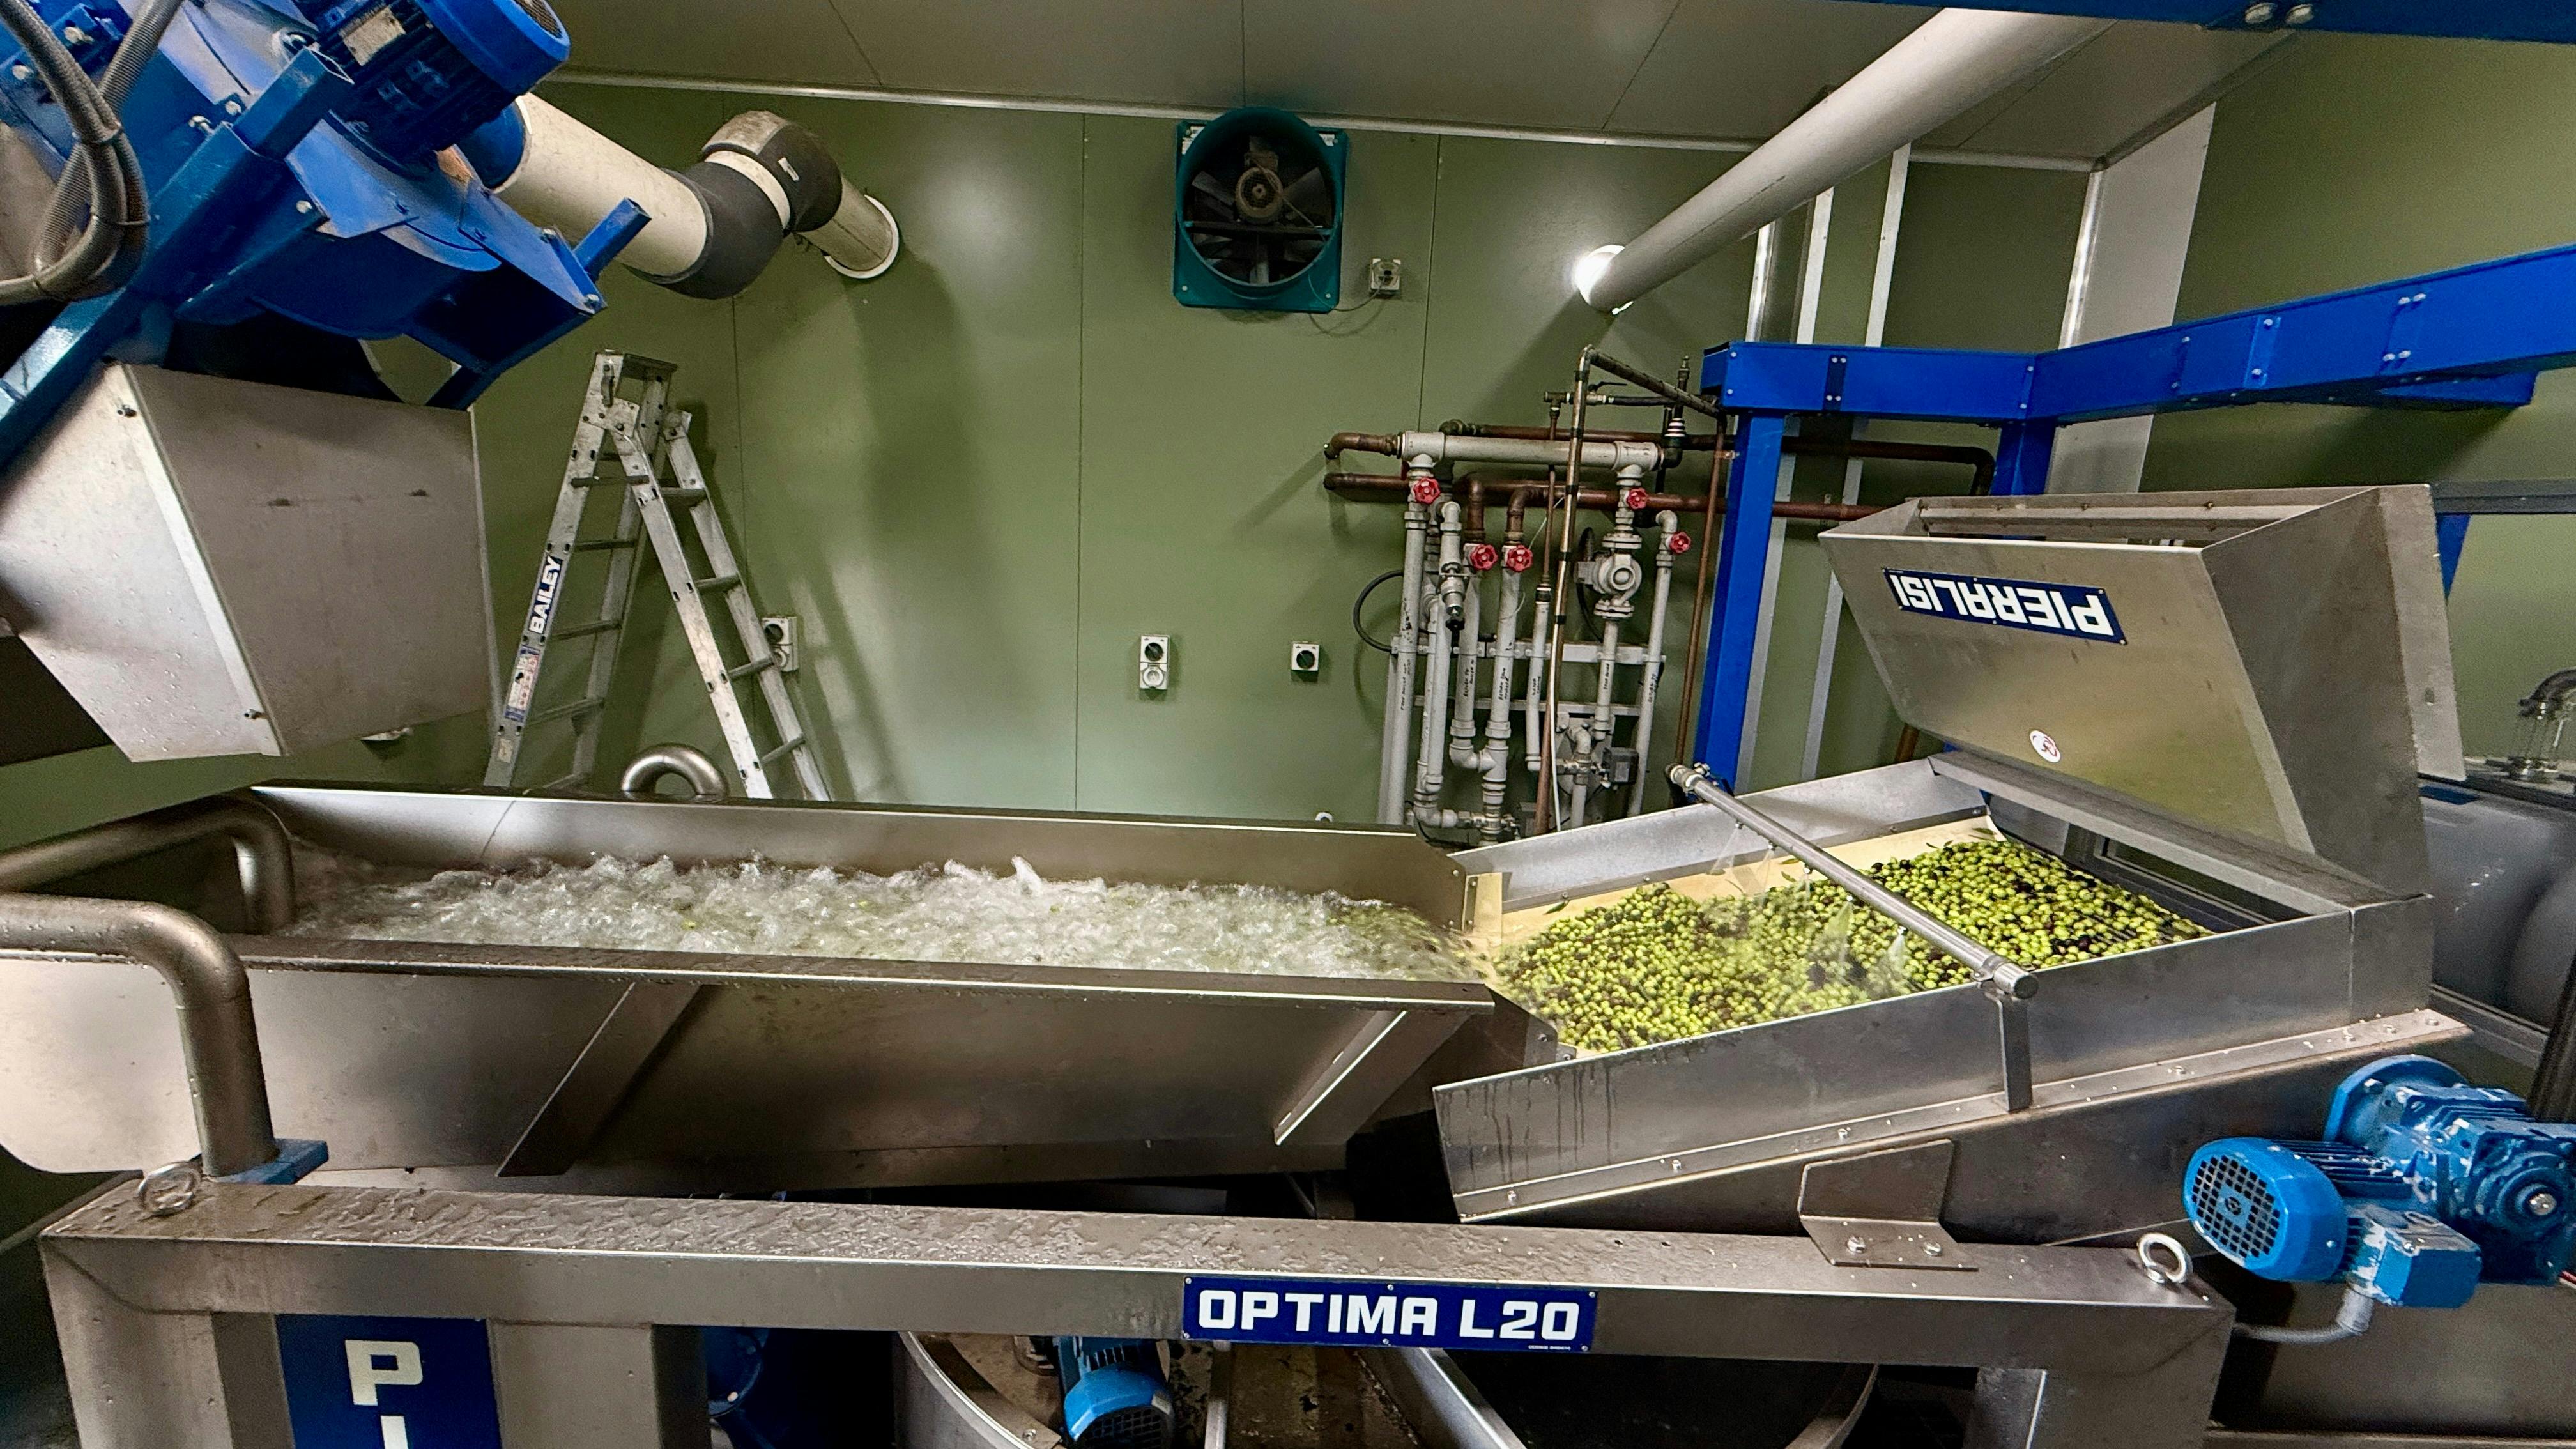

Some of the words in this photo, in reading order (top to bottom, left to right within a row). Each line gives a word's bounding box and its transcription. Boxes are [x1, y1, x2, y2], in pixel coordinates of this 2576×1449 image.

[529, 555, 562, 634] BAILEY
[1889, 574, 2115, 636] PIERALISI
[1199, 1289, 1439, 1336] OPTIMA
[1459, 1299, 1580, 1340] L20
